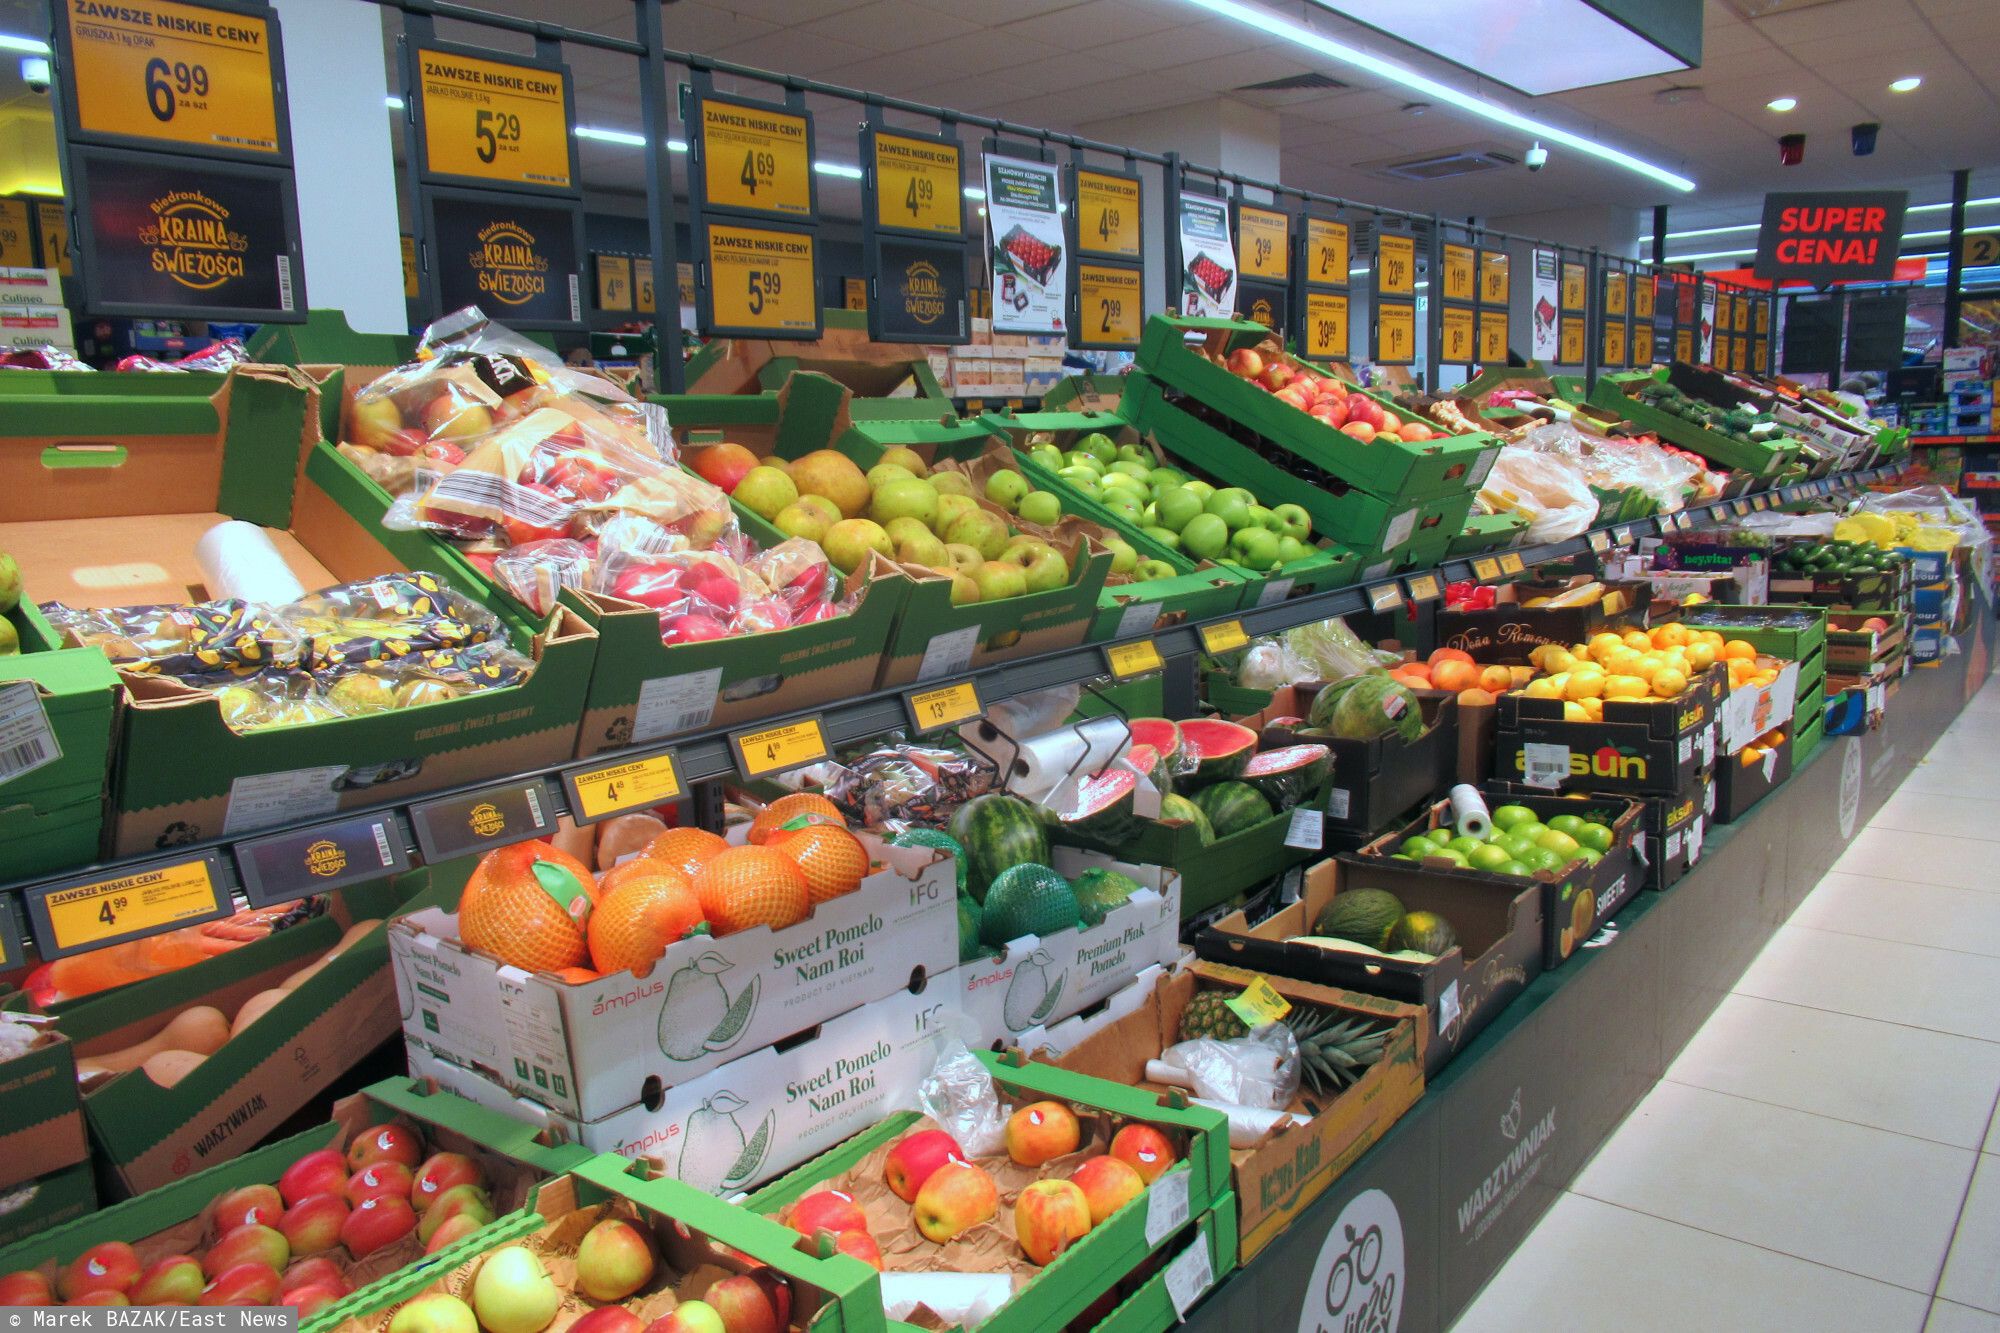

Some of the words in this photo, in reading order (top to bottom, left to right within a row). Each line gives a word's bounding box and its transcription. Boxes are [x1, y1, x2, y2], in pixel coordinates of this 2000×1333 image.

[75, 0, 153, 26] ZAWSZE
[157, 14, 213, 37] NISKIE
[217, 25, 260, 45] CENY
[425, 62, 481, 83] ZAWSZE
[483, 73, 524, 90] NISKIE
[526, 80, 558, 96] CENY
[706, 111, 747, 128] ZAWSZE
[748, 118, 778, 133] NISKIE
[779, 125, 803, 137] CENY
[879, 142, 911, 157] ZAWSZE
[911, 149, 936, 161] NISKIE
[936, 153, 955, 164] CENY
[150, 190, 231, 219] Biedronkowa
[159, 216, 229, 248] KRAINA
[477, 220, 536, 244] Biedronkowa
[1778, 206, 1888, 233] SUPER
[483, 243, 535, 269] KRAINA
[713, 235, 753, 249] ZAWSZE
[754, 240, 784, 252] NISKIE
[785, 243, 809, 254] CENY
[1775, 238, 1879, 265] CENA!
[1973, 239, 1992, 262] 2
[151, 247, 244, 279] ŚWIEŻOŚCI
[478, 270, 546, 295] ŚWIEŻOŚCI
[908, 277, 940, 295] KRAINA
[741, 735, 765, 745] ZAWSZE
[765, 730, 782, 739] NISKIE
[782, 726, 796, 735] CENY
[577, 772, 605, 784] ZAWSZE
[605, 767, 628, 778] NISKIE
[627, 763, 645, 772] CENY
[51, 886, 98, 904] ZAWSZE
[100, 878, 135, 893] NISKIE
[135, 872, 163, 885] CENY
[910, 879, 939, 907] IFG
[773, 935, 821, 970] Sweet
[825, 912, 884, 949] Pomelo
[1076, 936, 1122, 966] Premium
[1123, 921, 1145, 945] Pink
[795, 957, 834, 987] Nam
[838, 941, 865, 970] Roi
[1090, 948, 1126, 977] Pomelo
[783, 986, 824, 1009] PRODUCT
[826, 981, 837, 992] OF
[840, 966, 875, 985] VIETNAM
[785, 1066, 833, 1104] Sweet
[834, 1039, 892, 1081] Pomelo
[808, 1088, 847, 1119] Nam
[849, 1069, 876, 1098] Roi
[192, 1092, 268, 1160] WARZYWNIAK
[797, 1118, 836, 1140] PRODUCT
[849, 1092, 886, 1118] VIETNAM
[1457, 1105, 1556, 1234] WARZYWNIAK
